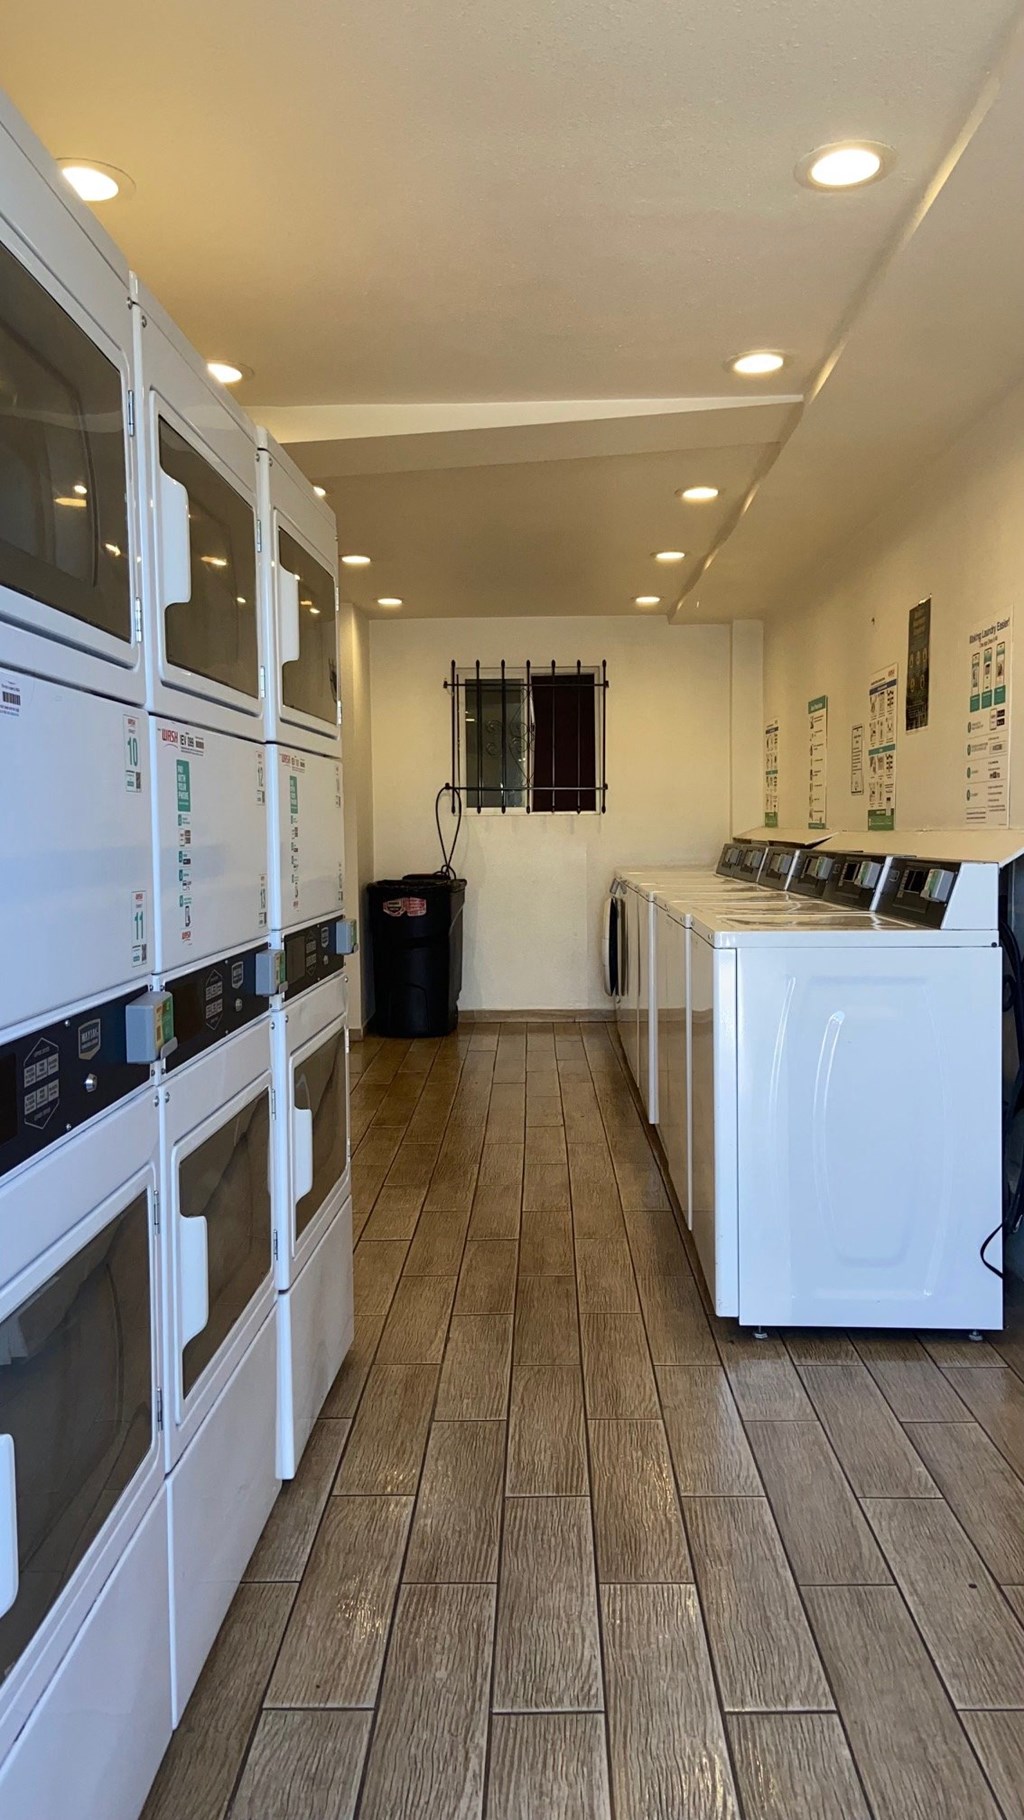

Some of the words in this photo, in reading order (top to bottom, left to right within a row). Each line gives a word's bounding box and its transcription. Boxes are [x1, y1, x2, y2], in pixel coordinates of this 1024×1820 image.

[982, 626, 995, 639] Laundry
[128, 737, 138, 766] 10
[135, 911, 144, 940] 11
